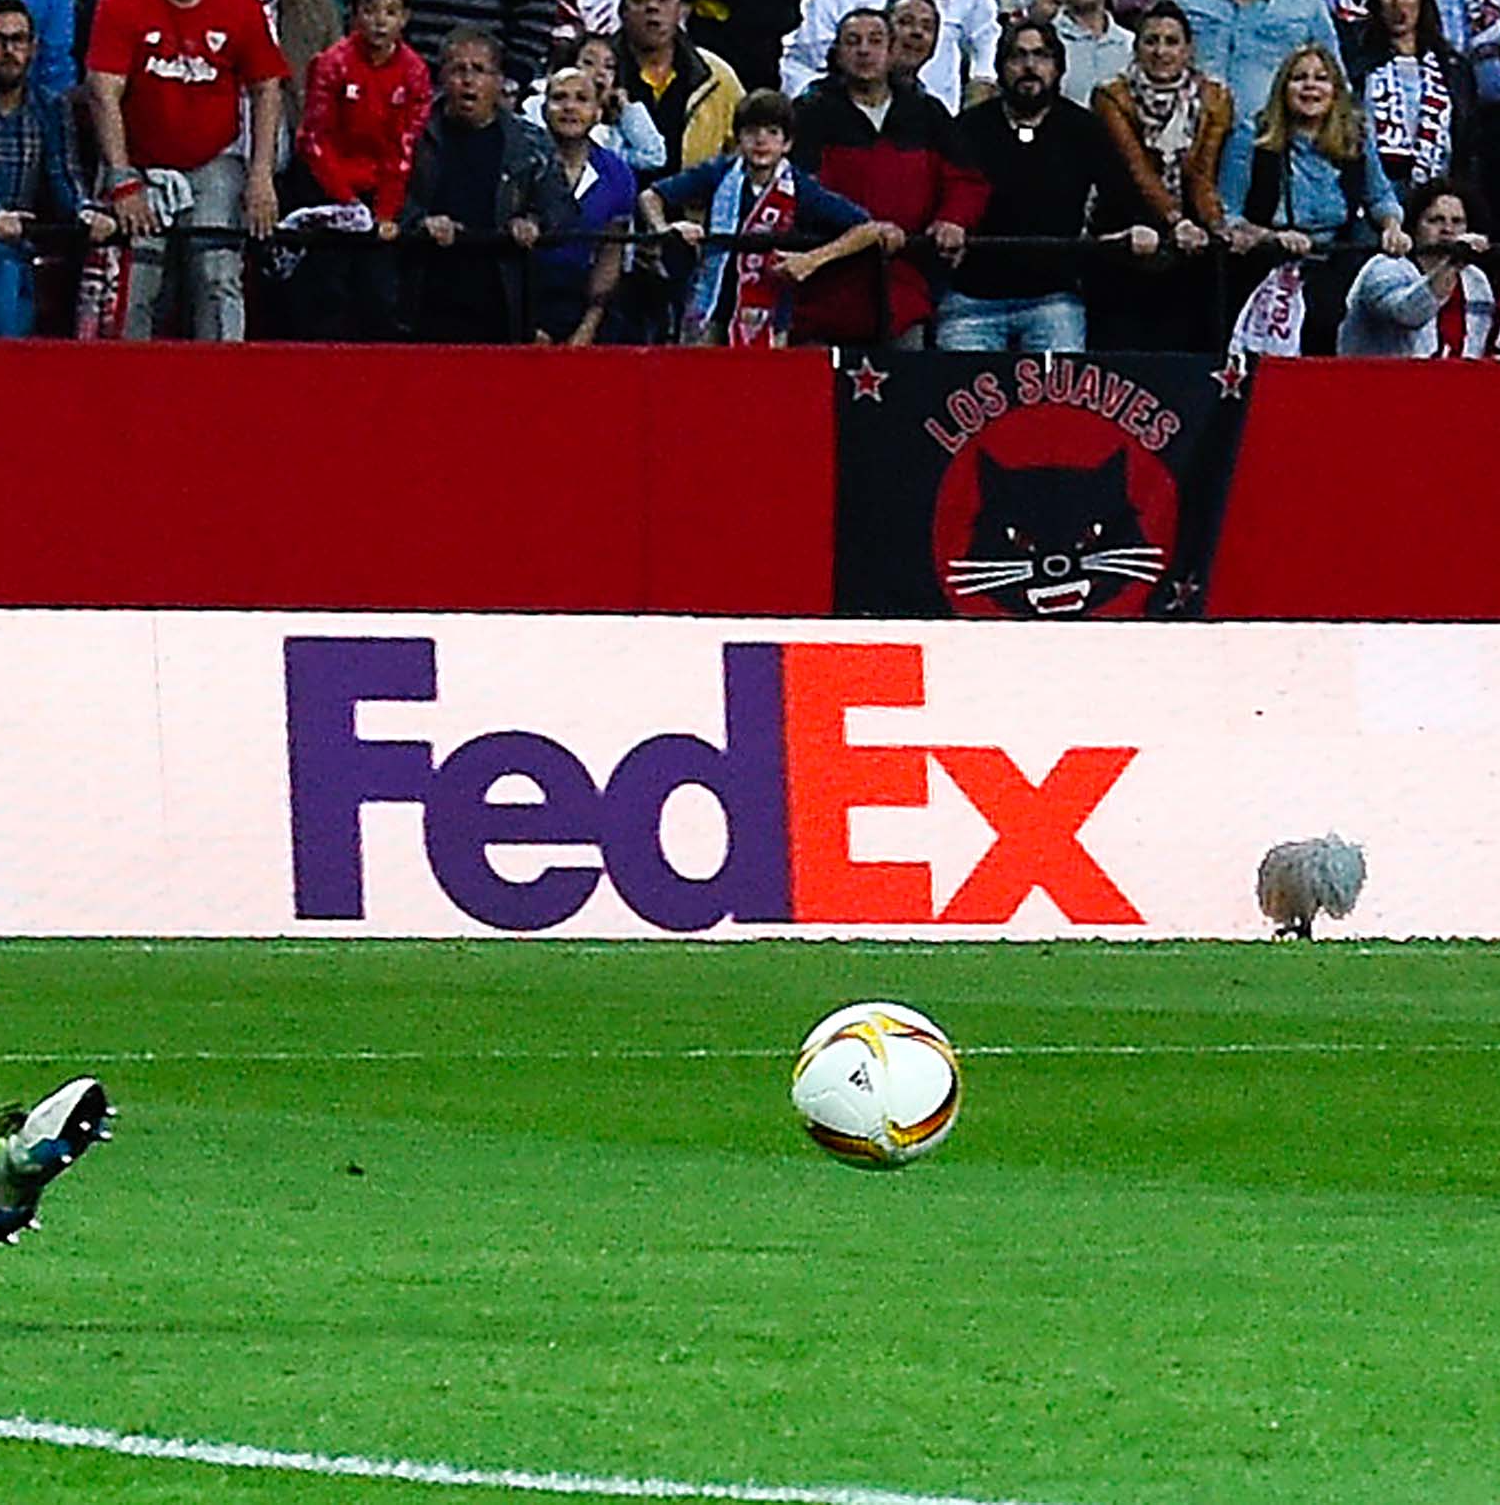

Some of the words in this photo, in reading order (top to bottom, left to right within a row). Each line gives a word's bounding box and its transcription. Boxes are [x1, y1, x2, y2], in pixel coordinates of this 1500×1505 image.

[924, 371, 1007, 454] LOS
[1015, 358, 1181, 451] SUAVES
[282, 635, 1147, 932] FedEx
